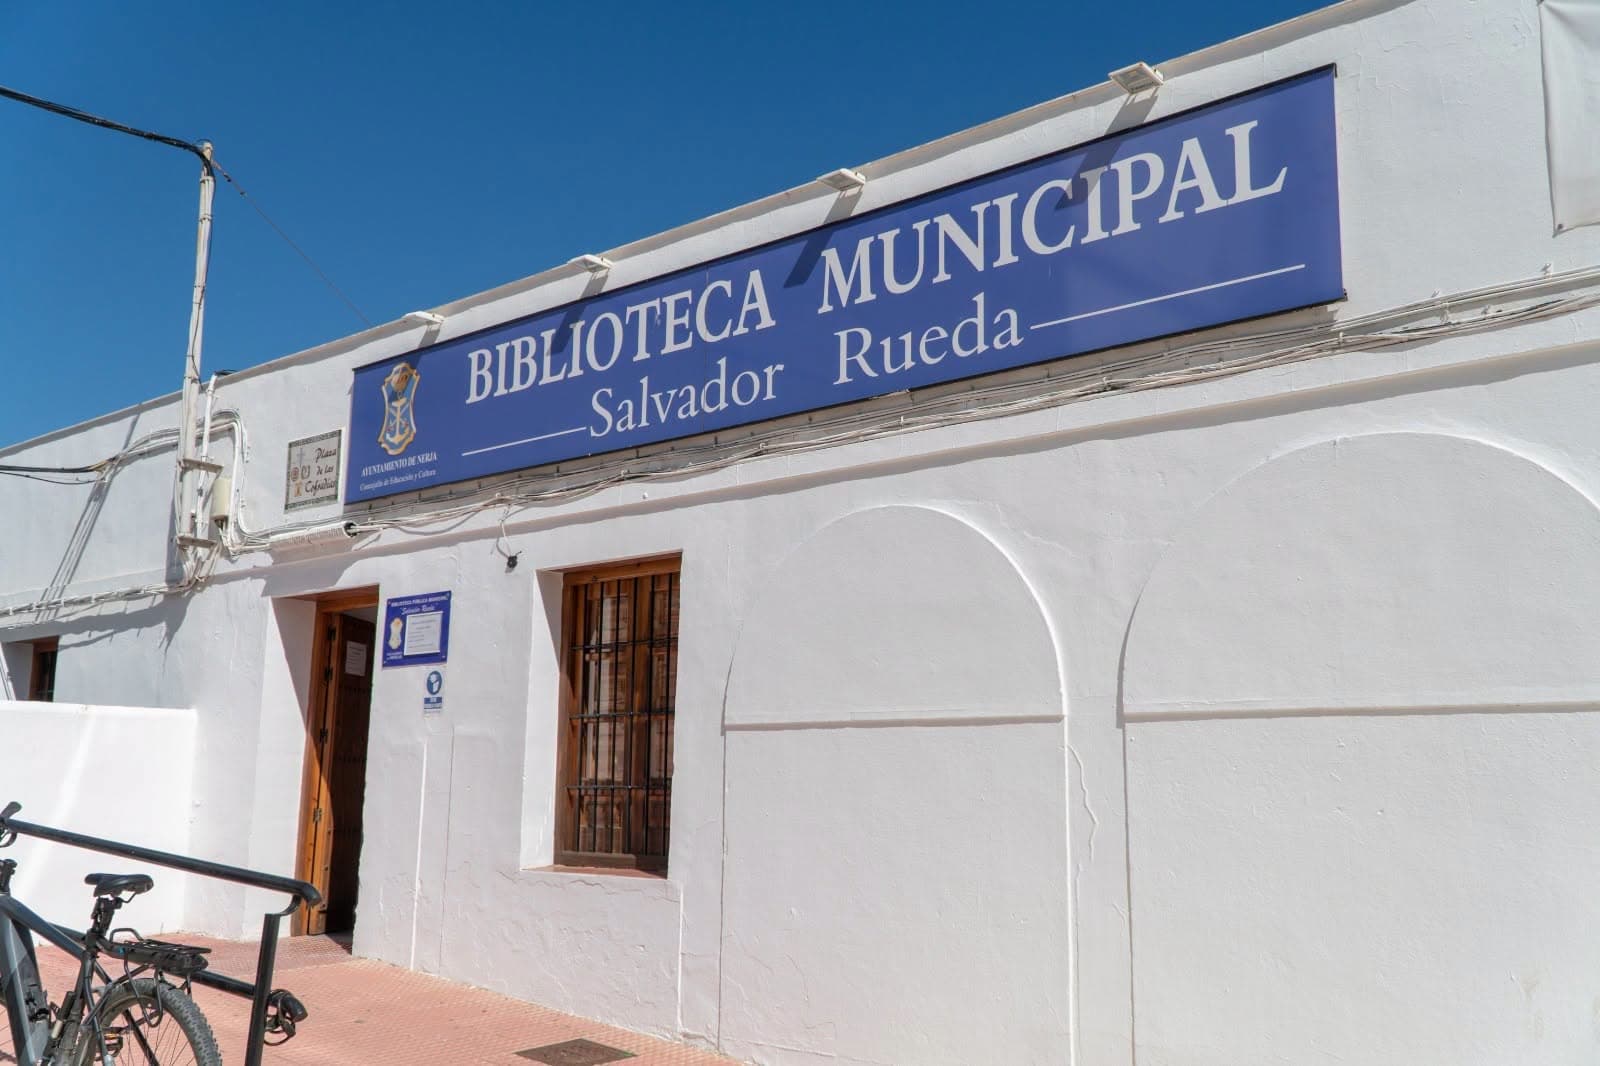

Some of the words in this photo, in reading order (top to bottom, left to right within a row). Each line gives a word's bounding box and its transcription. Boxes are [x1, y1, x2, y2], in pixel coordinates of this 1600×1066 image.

[465, 269, 776, 404] BIBLIOTECA
[817, 119, 1288, 314] MUNICIPAL
[589, 356, 785, 438] Salvador
[832, 292, 1025, 385] Rueda
[315, 447, 337, 463] Plaza
[361, 458, 407, 478] AYUNTAMIENTO
[408, 456, 416, 467] DE
[417, 451, 437, 465] NERJA
